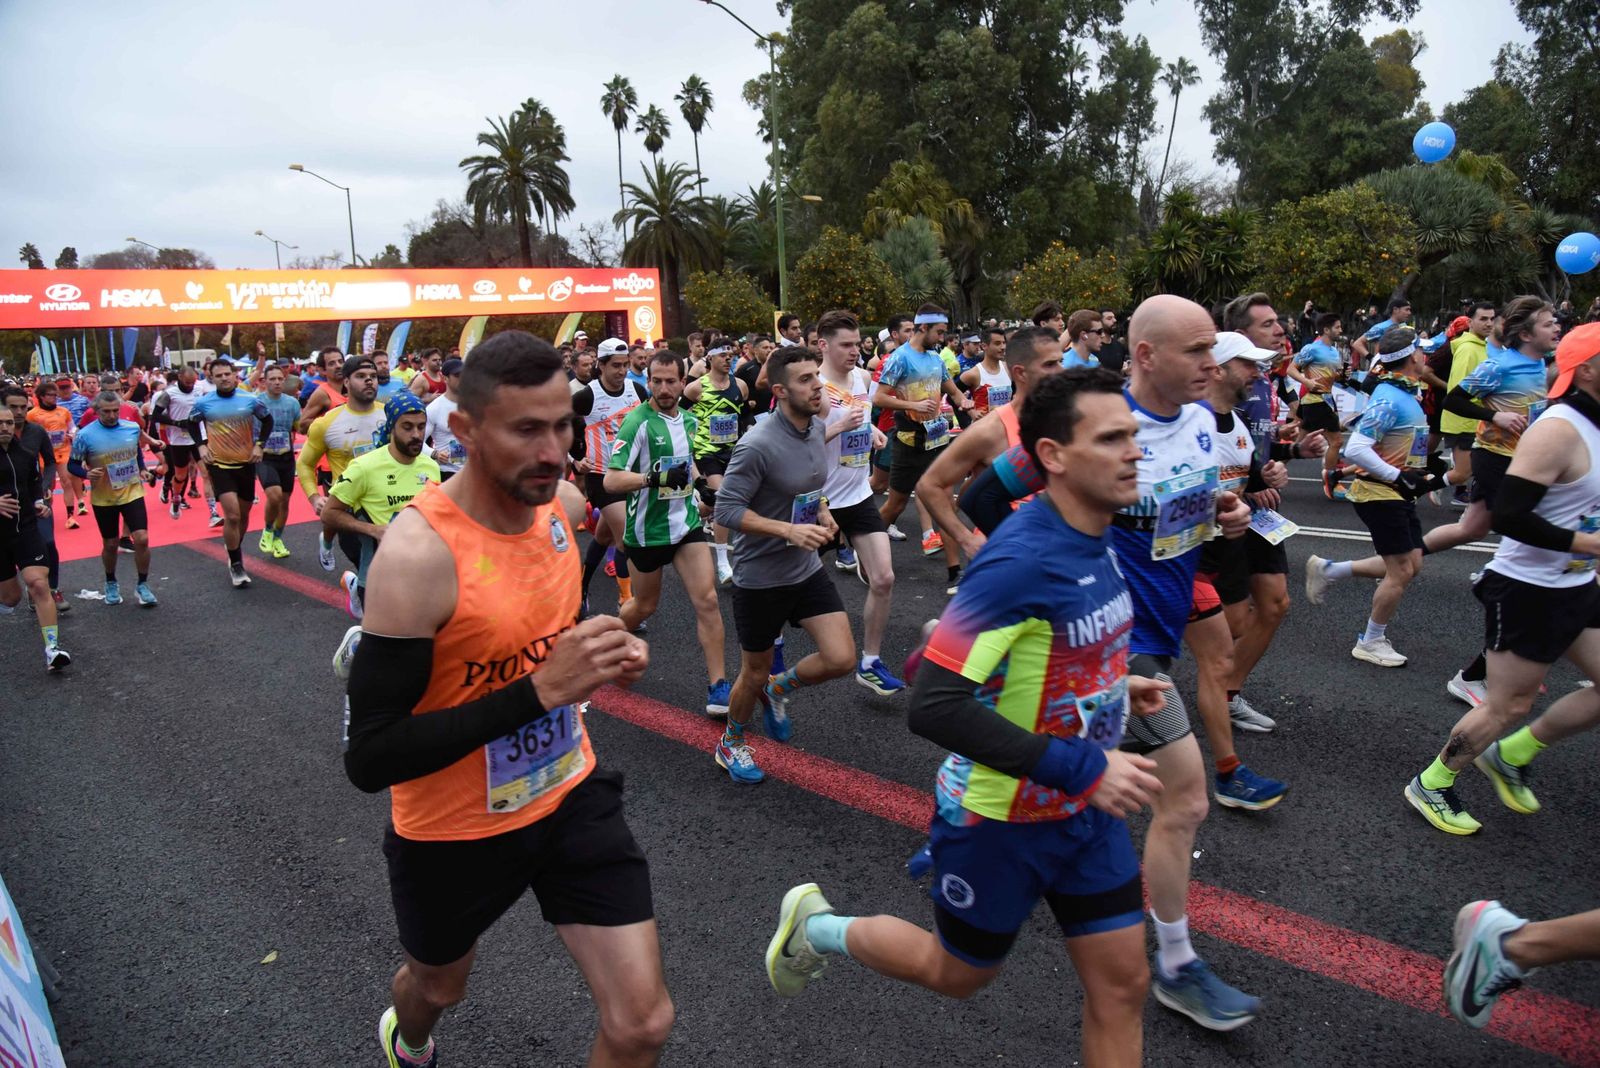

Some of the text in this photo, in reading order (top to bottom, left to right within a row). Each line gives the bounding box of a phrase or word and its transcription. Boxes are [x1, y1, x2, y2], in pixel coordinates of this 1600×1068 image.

[1423, 136, 1446, 149] HOKA
[100, 289, 167, 308] HOKA
[415, 284, 463, 300] HOKA
[40, 302, 90, 311] HYUNDAI
[993, 391, 1008, 402] 2335
[714, 420, 734, 432] 3655
[847, 432, 870, 449] 2570
[1169, 489, 1208, 523] 2966
[506, 708, 567, 763] 3631
